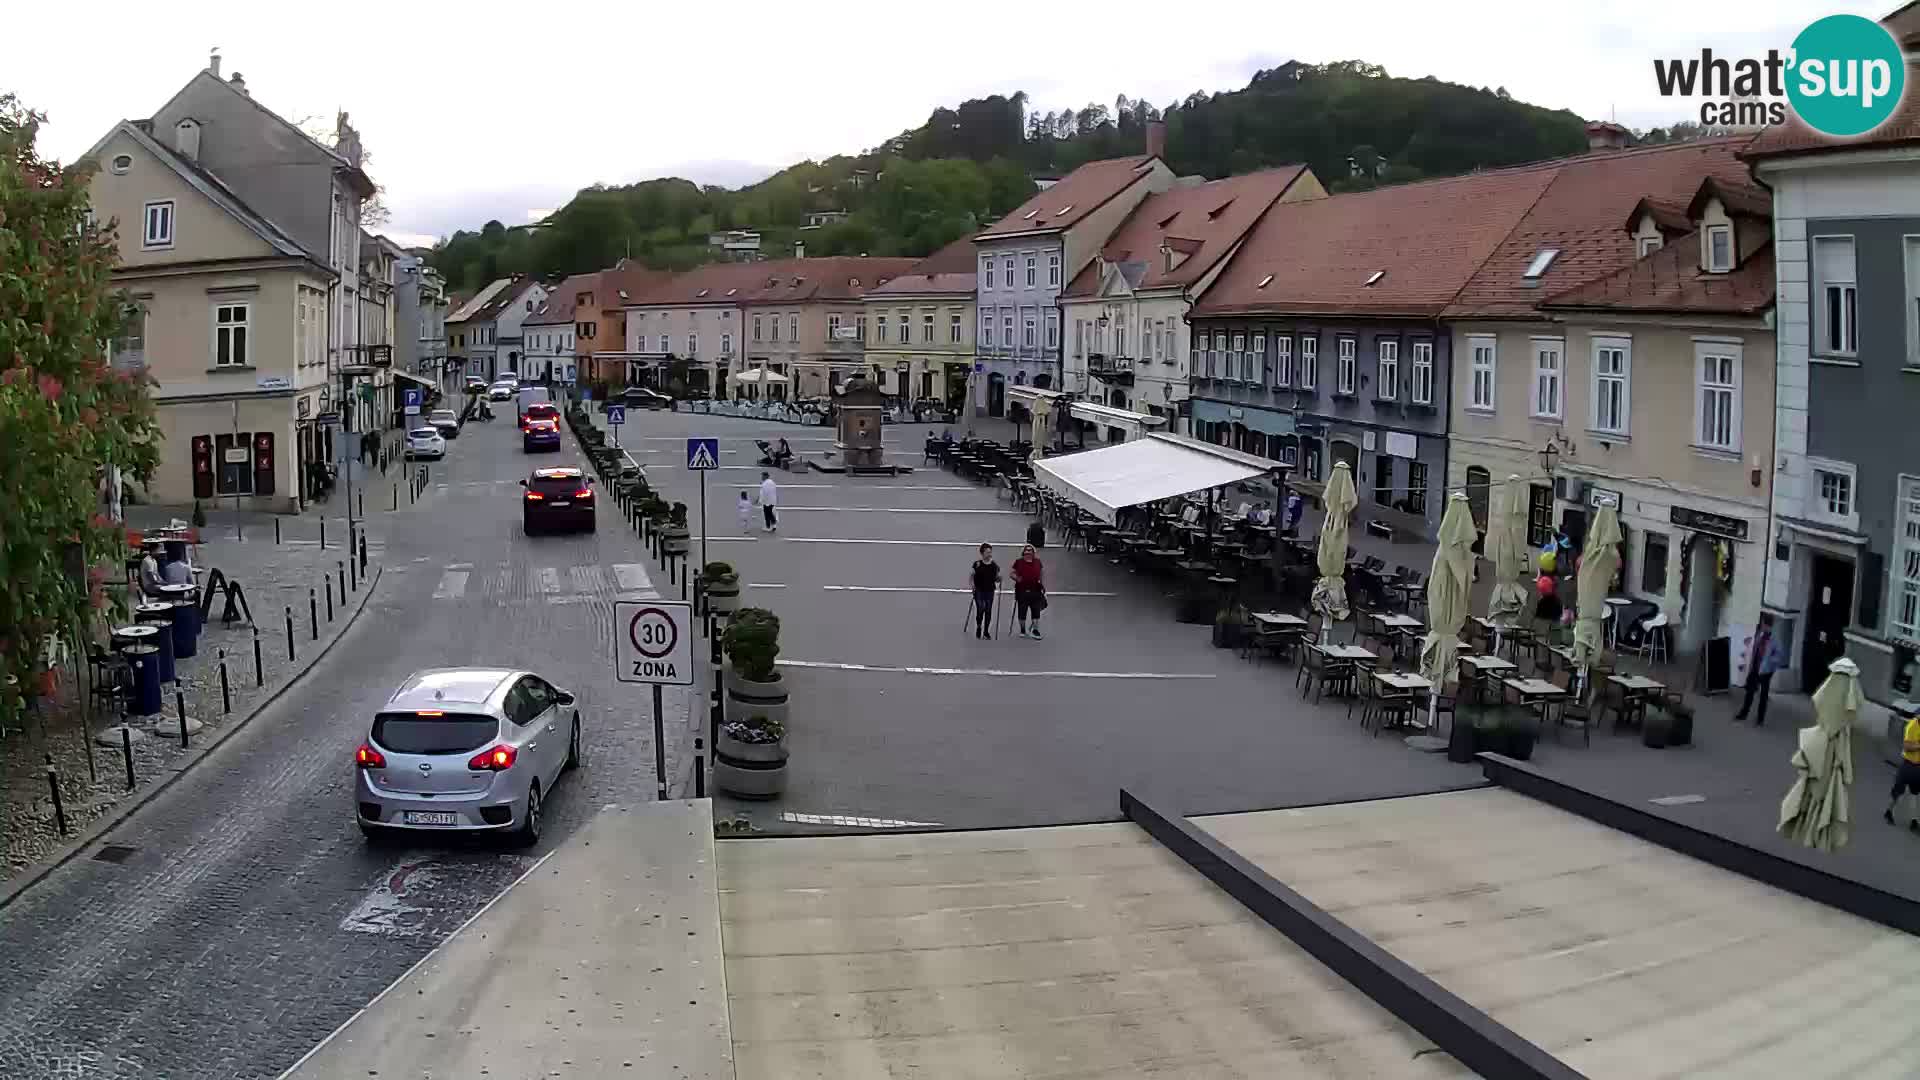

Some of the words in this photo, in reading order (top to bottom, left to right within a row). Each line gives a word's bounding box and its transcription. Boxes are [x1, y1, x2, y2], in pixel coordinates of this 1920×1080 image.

[408, 393, 417, 404] P
[642, 623, 666, 645] 30
[632, 660, 677, 678] ZONA
